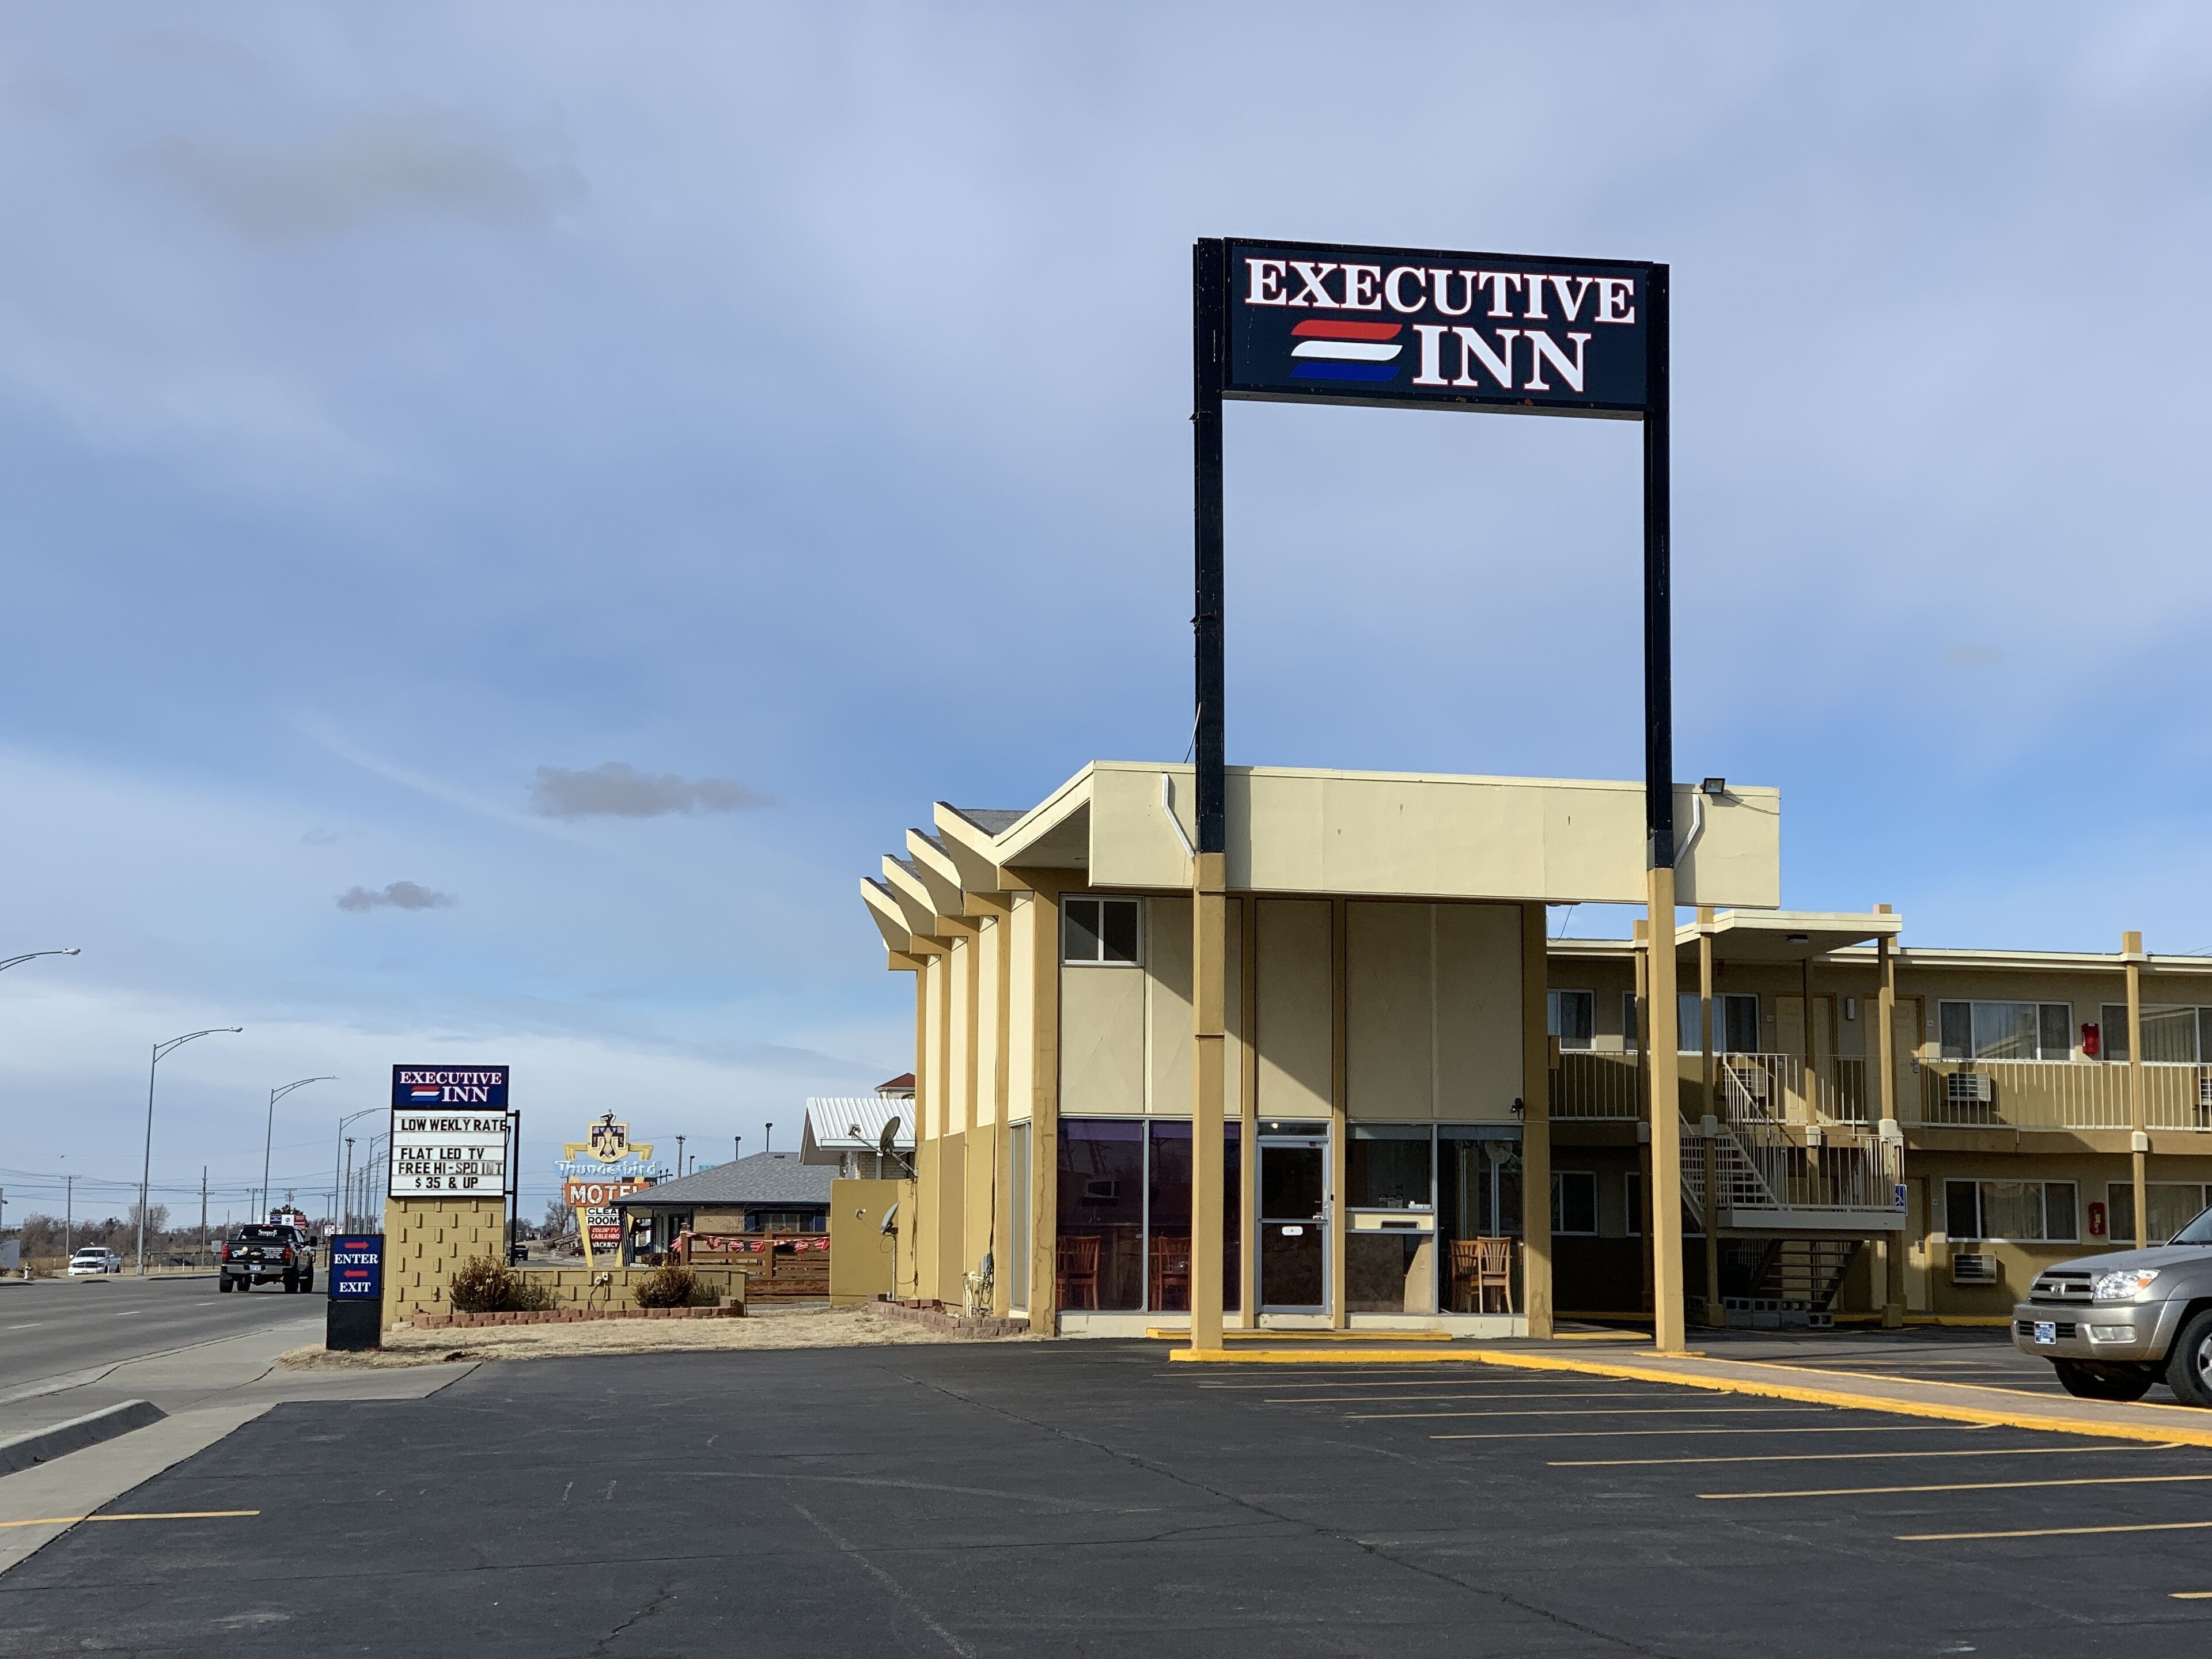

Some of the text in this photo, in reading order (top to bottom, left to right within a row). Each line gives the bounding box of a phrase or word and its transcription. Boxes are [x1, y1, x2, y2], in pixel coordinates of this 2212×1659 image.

[1245, 258, 1636, 324] EXECUTIVE
[1412, 324, 1592, 392] INN
[400, 1071, 502, 1085] EXECUTIVE
[442, 1086, 490, 1103] INN
[401, 1119, 427, 1131] LOW
[430, 1119, 471, 1131] WEKLY
[400, 1147, 484, 1160] FLAT LED TV
[398, 1162, 430, 1174] FREE
[555, 1161, 657, 1176] Thunderbird
[448, 1177, 457, 1189] &
[463, 1177, 479, 1189] UP
[334, 1253, 379, 1264] ENTER
[339, 1282, 372, 1293] EXIT
